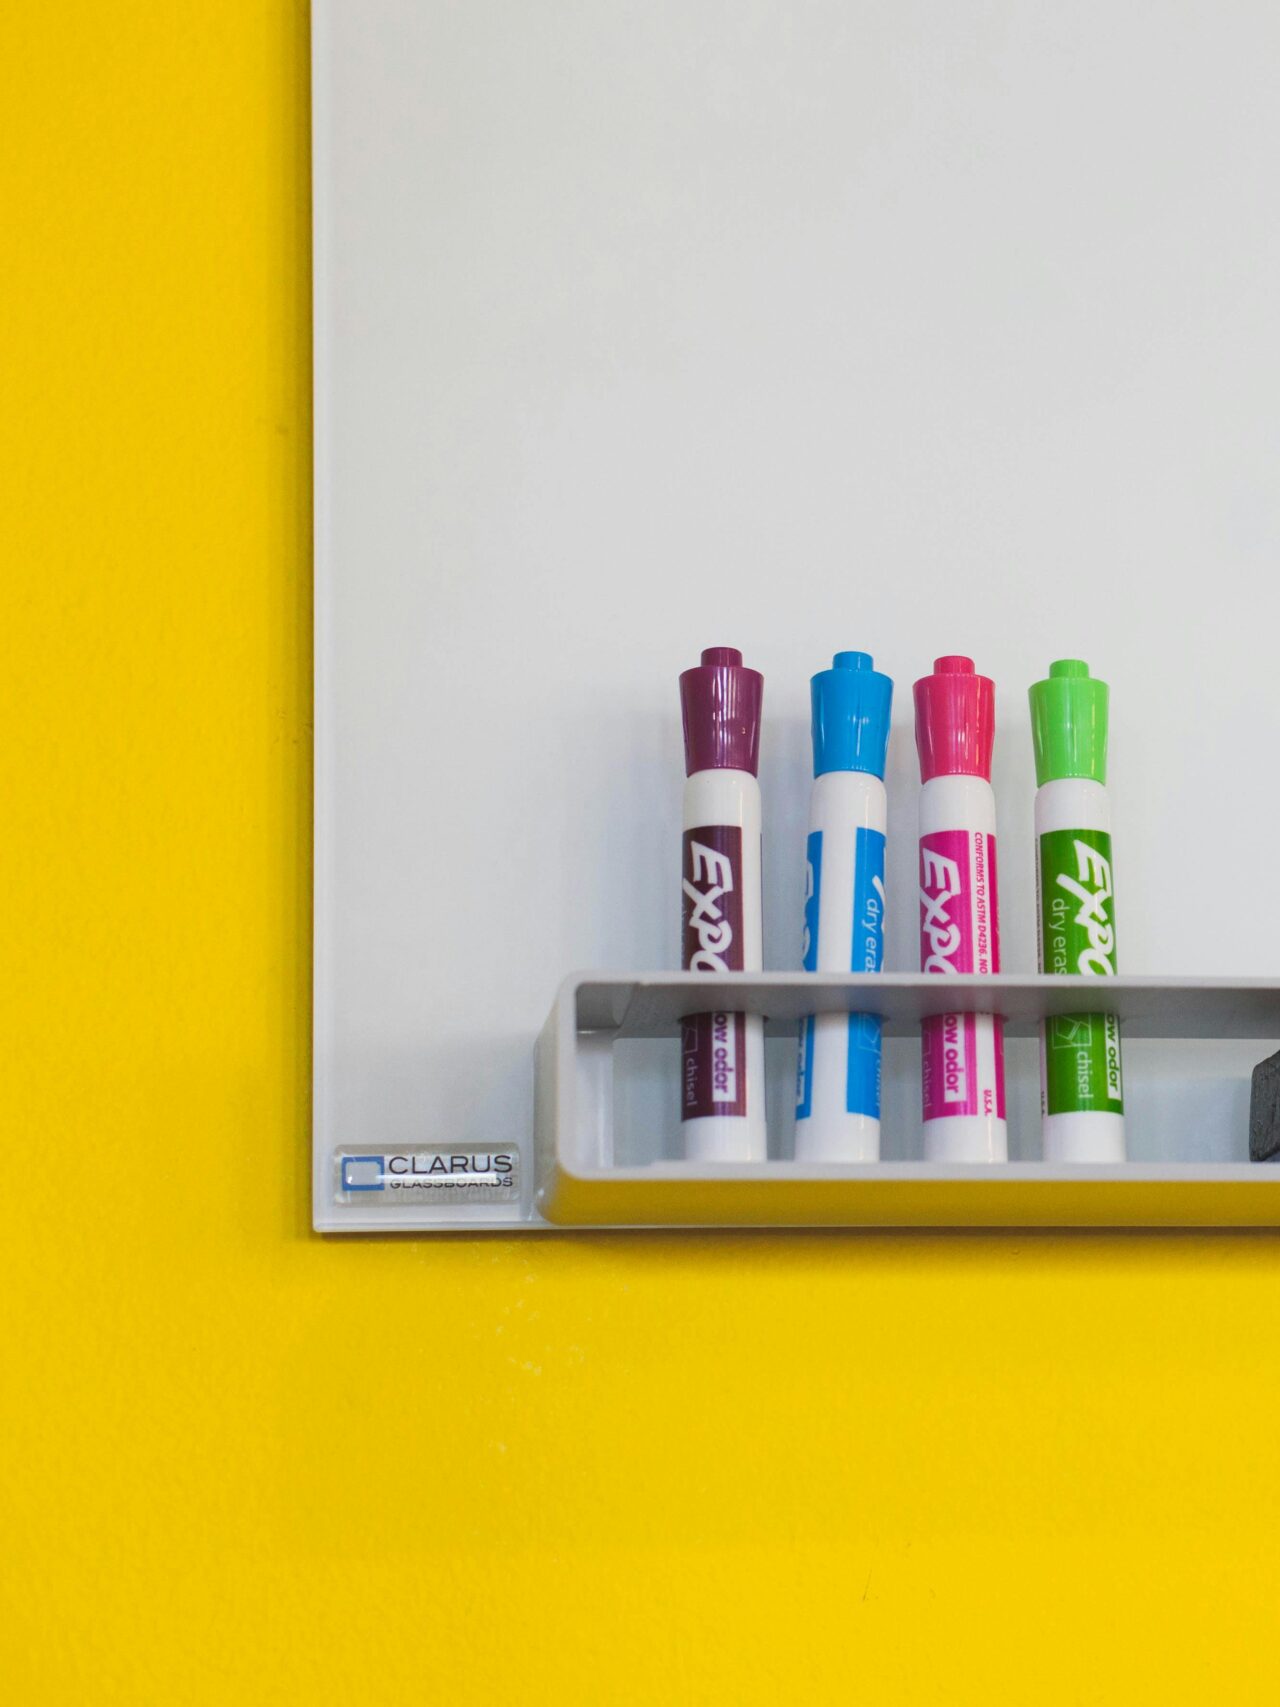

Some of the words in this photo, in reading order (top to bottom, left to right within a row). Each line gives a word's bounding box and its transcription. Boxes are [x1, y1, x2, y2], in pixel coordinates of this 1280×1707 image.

[975, 832, 985, 882] CONFORMS
[976, 884, 985, 896] TO
[862, 898, 880, 934] dry
[977, 897, 986, 924] ASTM
[1049, 898, 1070, 932] dry
[864, 936, 877, 972] era
[978, 925, 988, 957] D4236.
[1052, 935, 1067, 976] eras
[714, 1012, 728, 1043] ow
[945, 1014, 958, 1045] ow
[1107, 1013, 1117, 1042] ow
[686, 1057, 698, 1107] chisel
[714, 1047, 734, 1094] odor
[945, 1048, 965, 1094] odor
[1076, 1051, 1094, 1099] chisel
[1107, 1046, 1120, 1093] odor
[983, 1088, 992, 1117] U.S.A.
[388, 1155, 513, 1174] CLARUS
[389, 1177, 513, 1190] GLASSBOARDS
